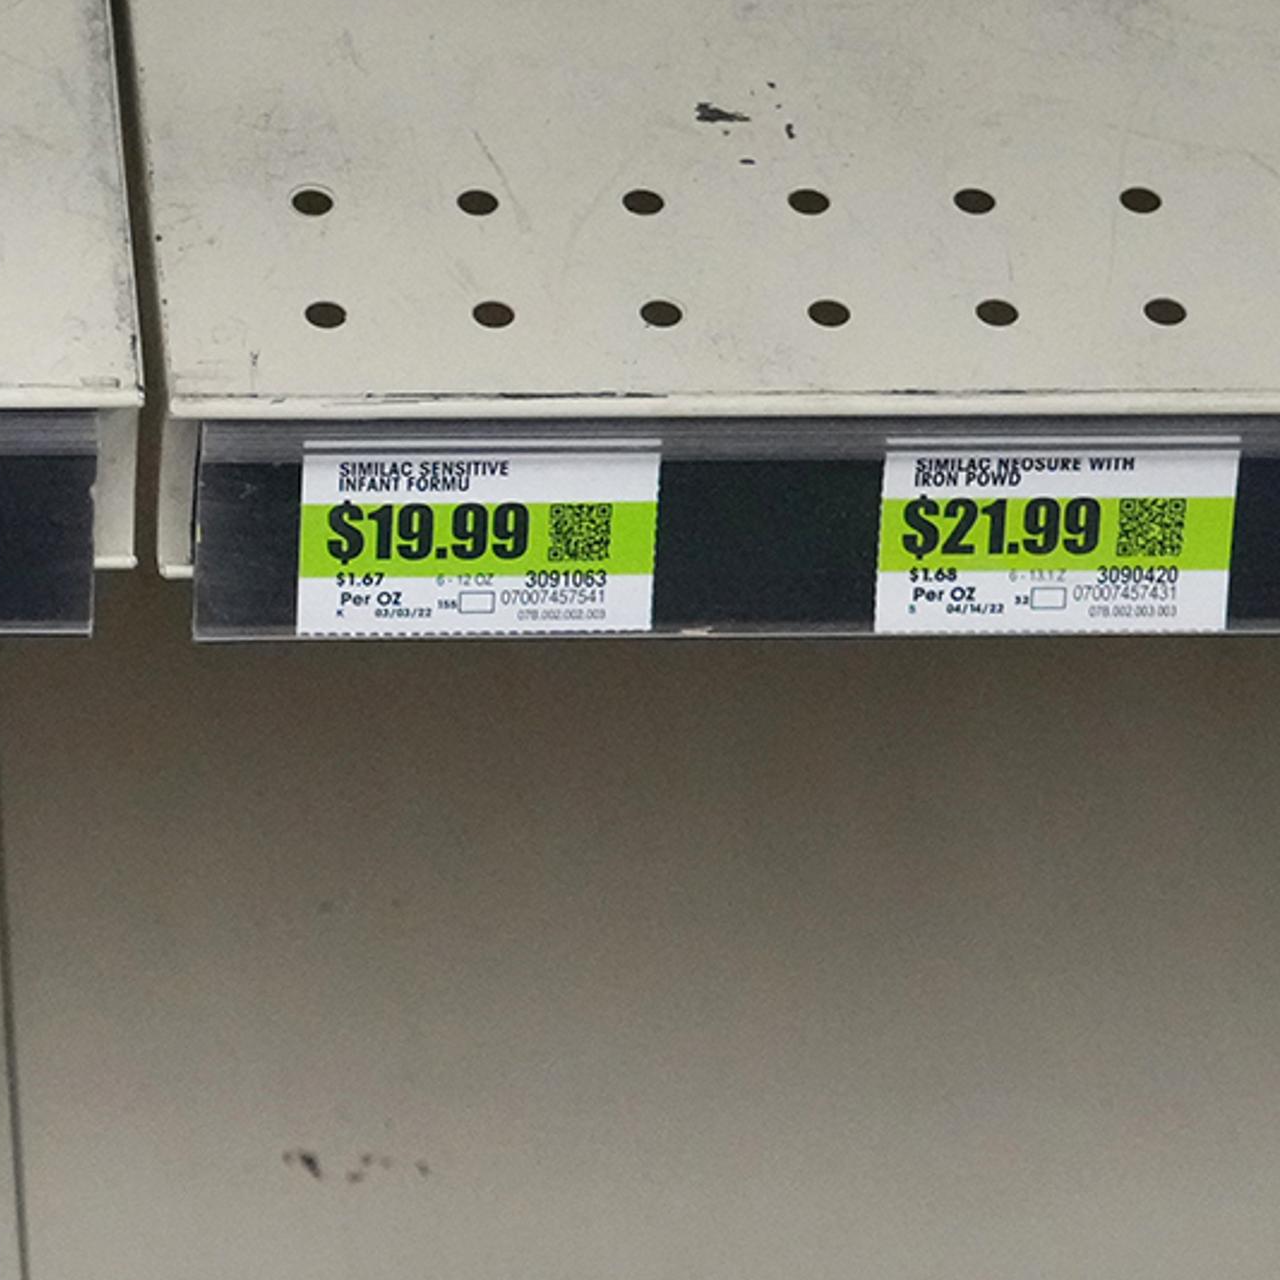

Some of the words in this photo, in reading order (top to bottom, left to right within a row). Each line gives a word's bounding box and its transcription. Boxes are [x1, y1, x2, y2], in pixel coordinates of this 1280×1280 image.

[340, 461, 412, 477] SIMILAC
[420, 461, 509, 477] SENSITIVE
[915, 457, 991, 472] SIMILAC
[998, 457, 1082, 472] NEOSURE
[1090, 457, 1135, 471] WITH
[339, 477, 399, 492] INFANT
[406, 477, 470, 492] FORMU
[914, 472, 958, 487] IRON
[965, 472, 1021, 487] POWD
[327, 500, 529, 565] $19.99
[902, 494, 1101, 560] $21.99
[336, 572, 383, 587] $1.67
[525, 570, 607, 588] 3091063
[909, 568, 957, 583] $1.68
[1097, 566, 1178, 584] 3090420
[341, 592, 370, 606] Per
[377, 592, 402, 606] OZ
[501, 589, 605, 605] 07007457541
[913, 587, 943, 602] Per
[951, 587, 976, 601] OZ
[1073, 585, 1177, 601] 07007457431
